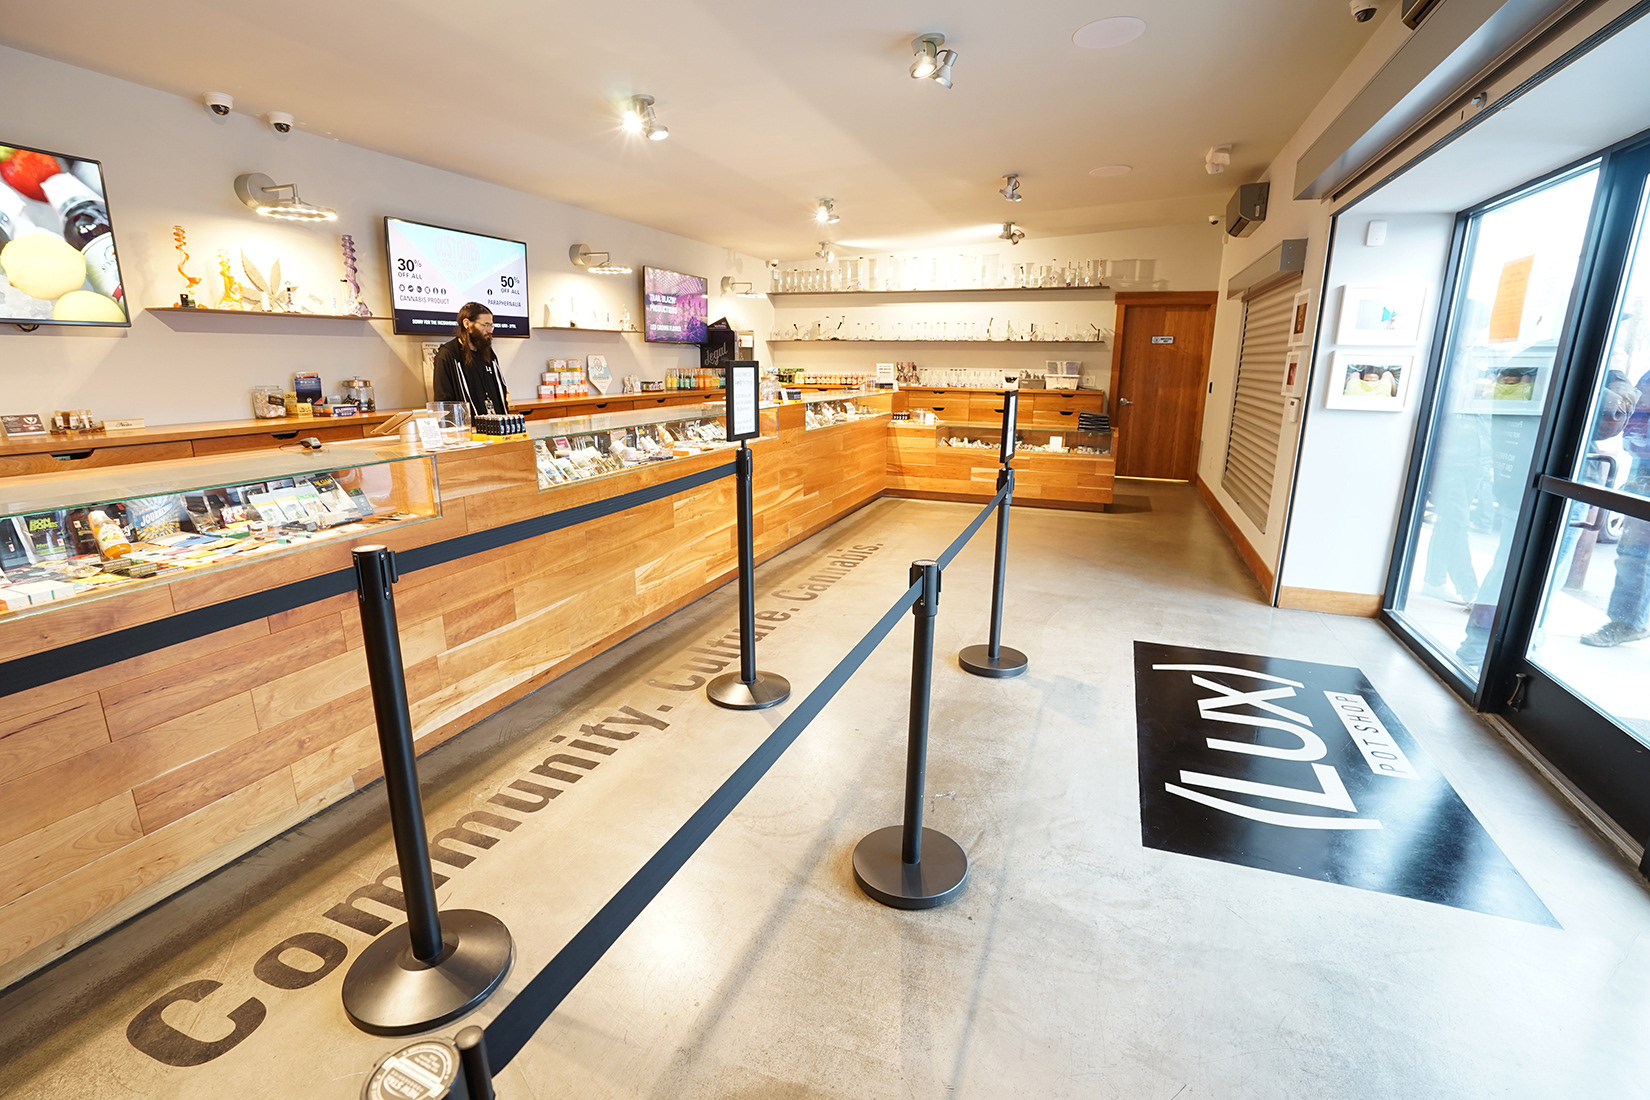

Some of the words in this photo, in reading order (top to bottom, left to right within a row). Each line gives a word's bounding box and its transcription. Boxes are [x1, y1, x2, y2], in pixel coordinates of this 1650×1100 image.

[397, 258, 422, 272] 30%
[500, 275, 520, 288] 50%
[399, 295, 427, 304] CANNABIS
[704, 341, 729, 366] Legal
[1334, 695, 1380, 734] SHOP
[1361, 738, 1409, 774] POT
[125, 704, 674, 1067] Community.
[646, 607, 801, 692] Culture.
[771, 543, 884, 602] Cannabis.
